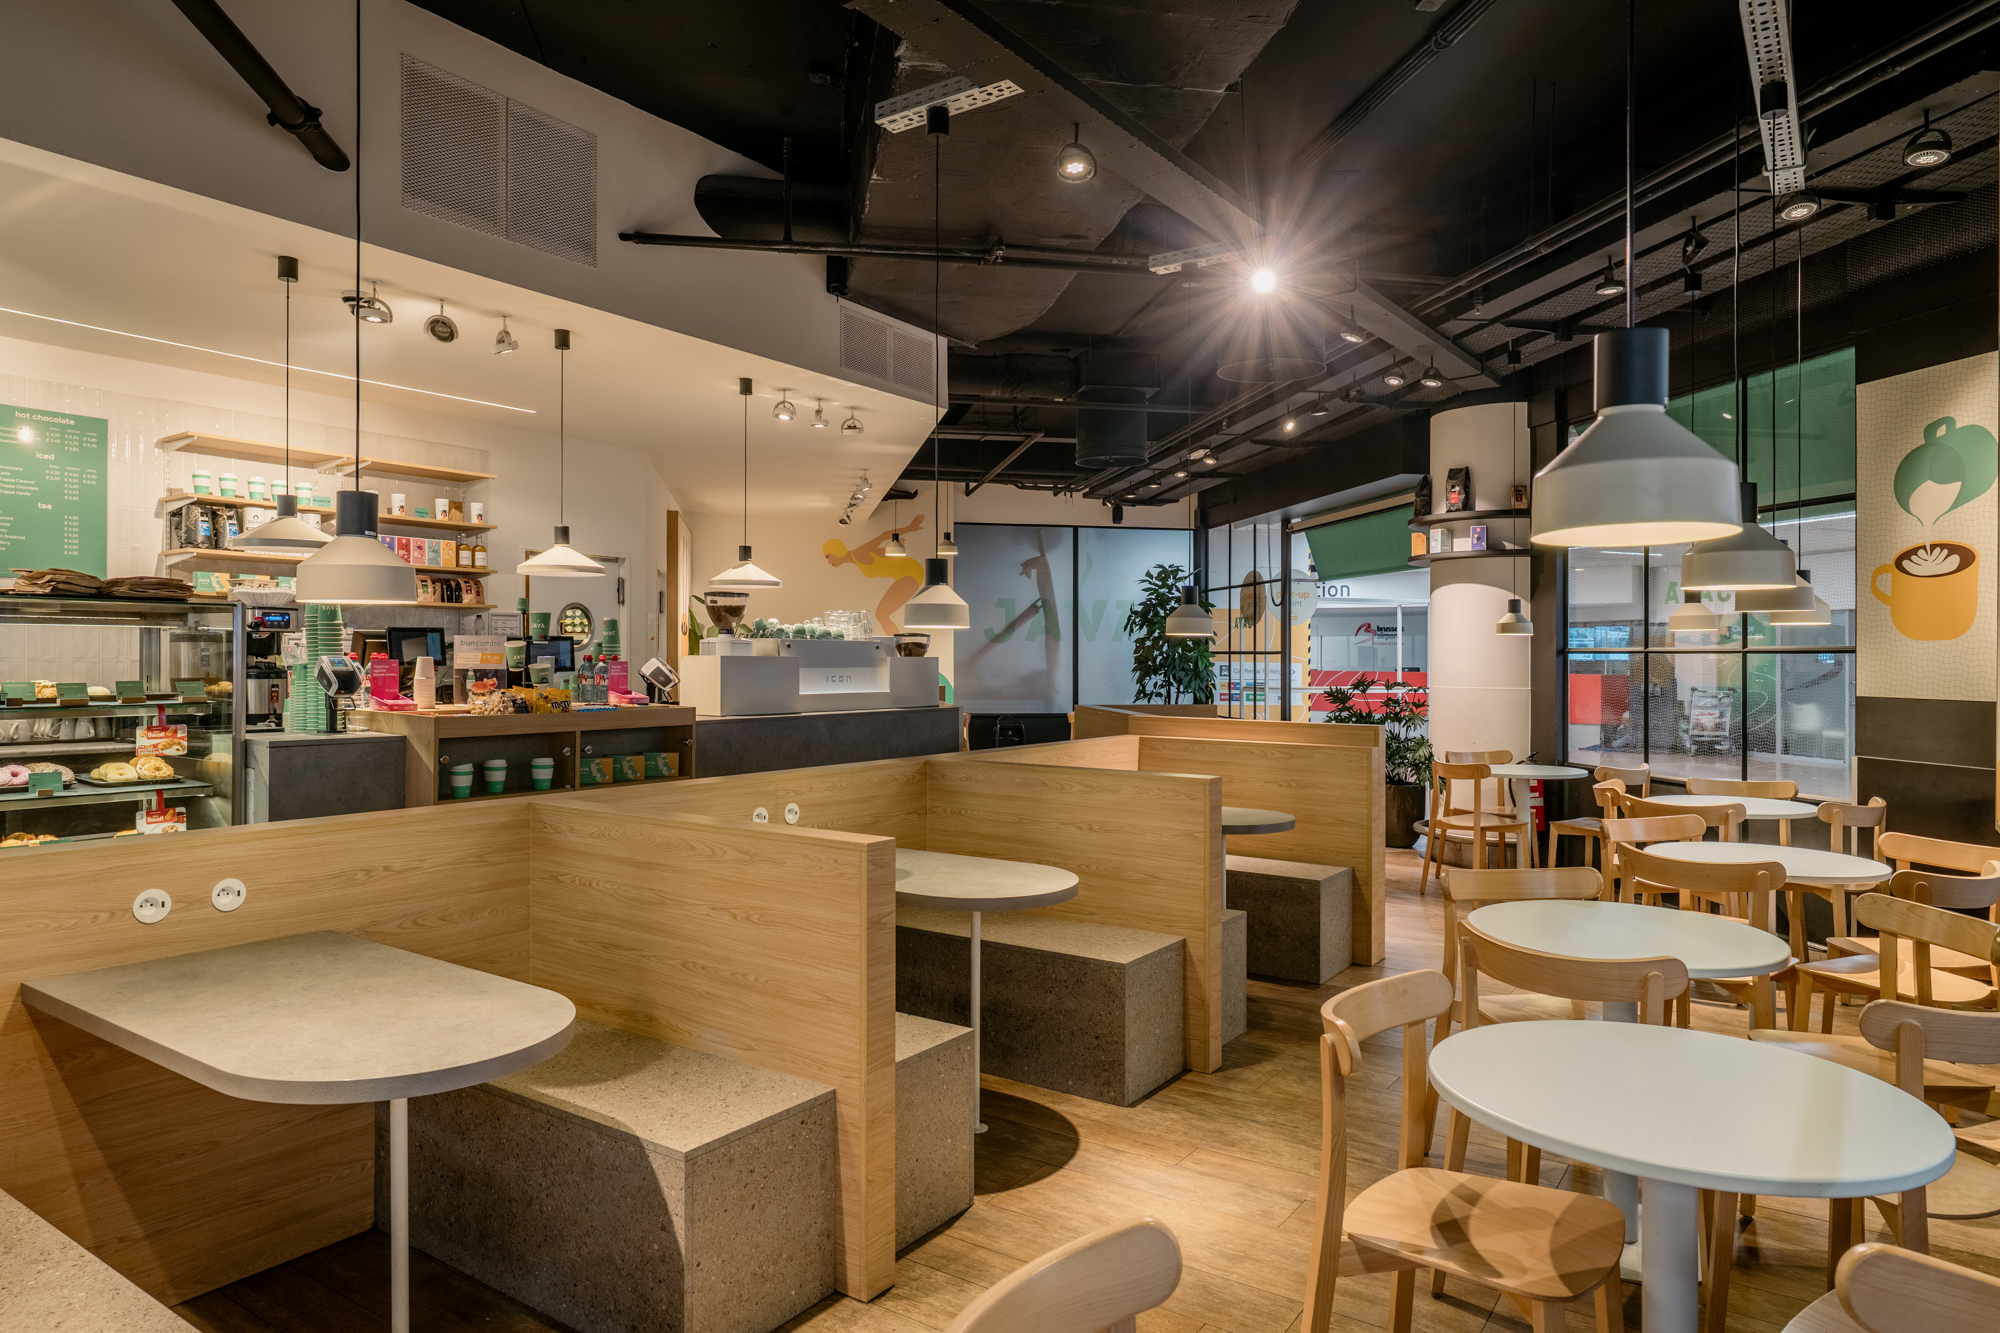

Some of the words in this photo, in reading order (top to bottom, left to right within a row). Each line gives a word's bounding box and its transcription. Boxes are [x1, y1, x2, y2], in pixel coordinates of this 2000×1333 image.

[15, 411, 30, 419] hot
[32, 414, 75, 425] chocolate
[36, 452, 55, 460] iced
[38, 502, 52, 510] tea
[1276, 591, 1310, 600] pk-up
[1377, 632, 1398, 641] airpor
